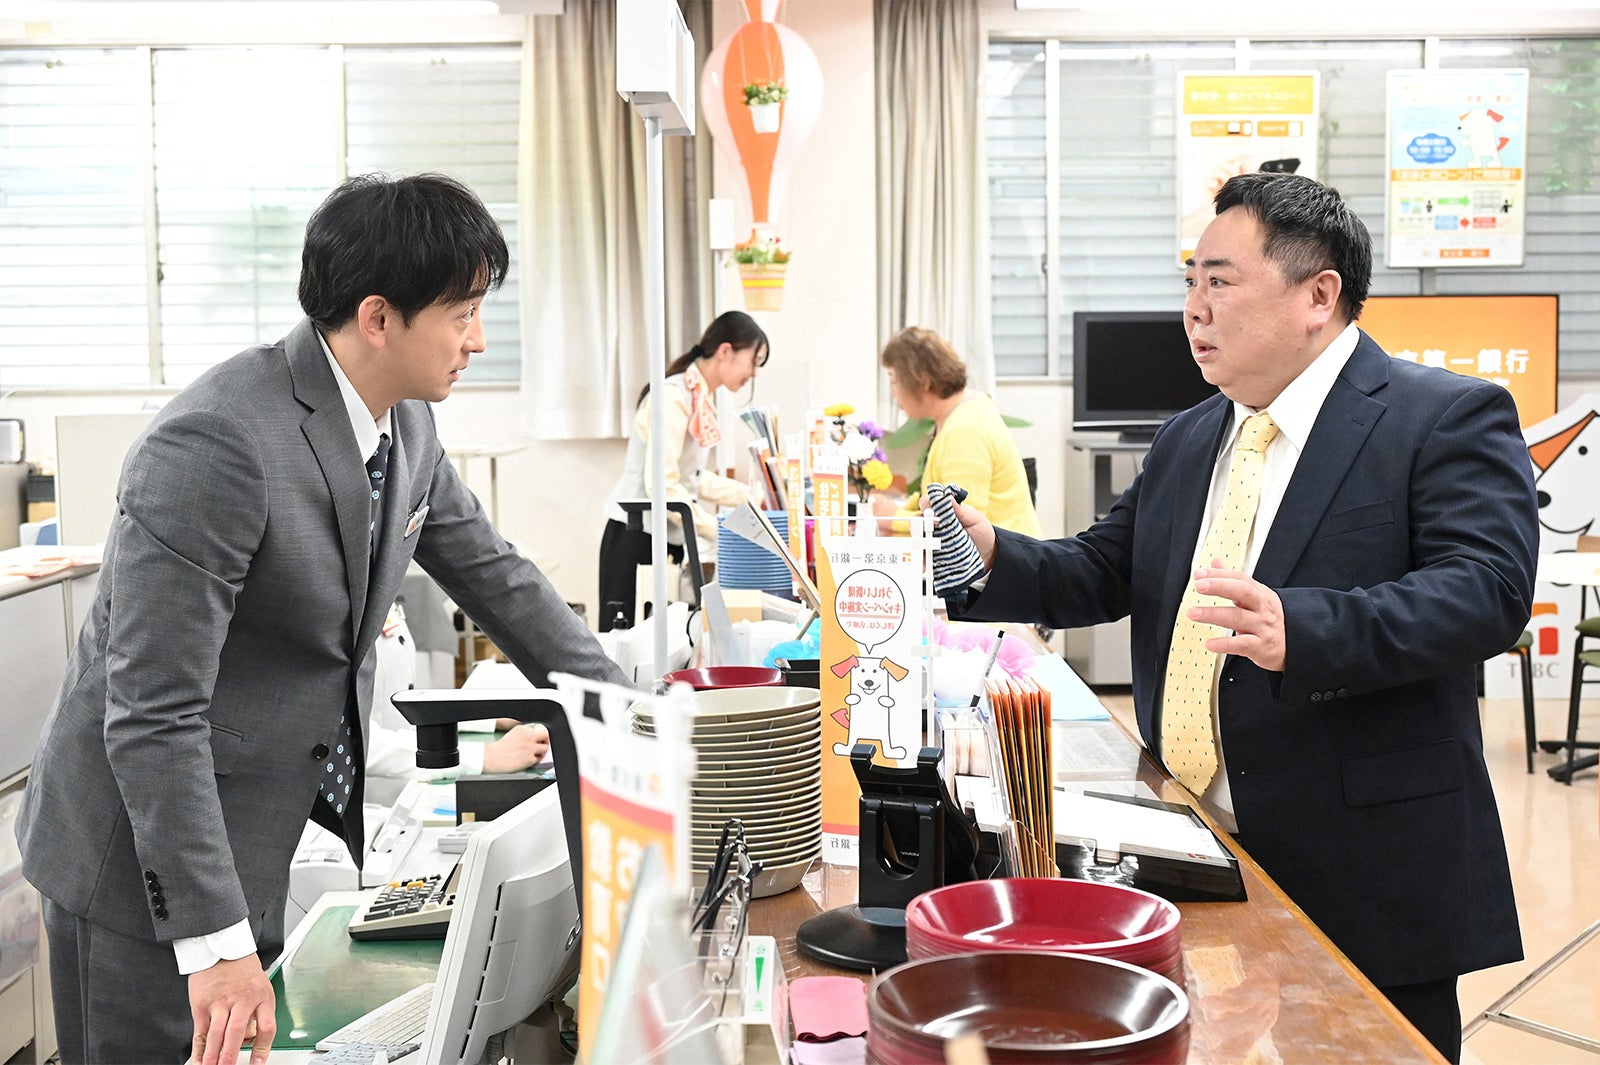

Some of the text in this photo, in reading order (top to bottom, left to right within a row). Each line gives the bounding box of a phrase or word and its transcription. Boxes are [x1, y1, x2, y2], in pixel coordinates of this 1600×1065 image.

[1387, 349, 1530, 374] 第一銀行
[1507, 662, 1560, 679] TBC
